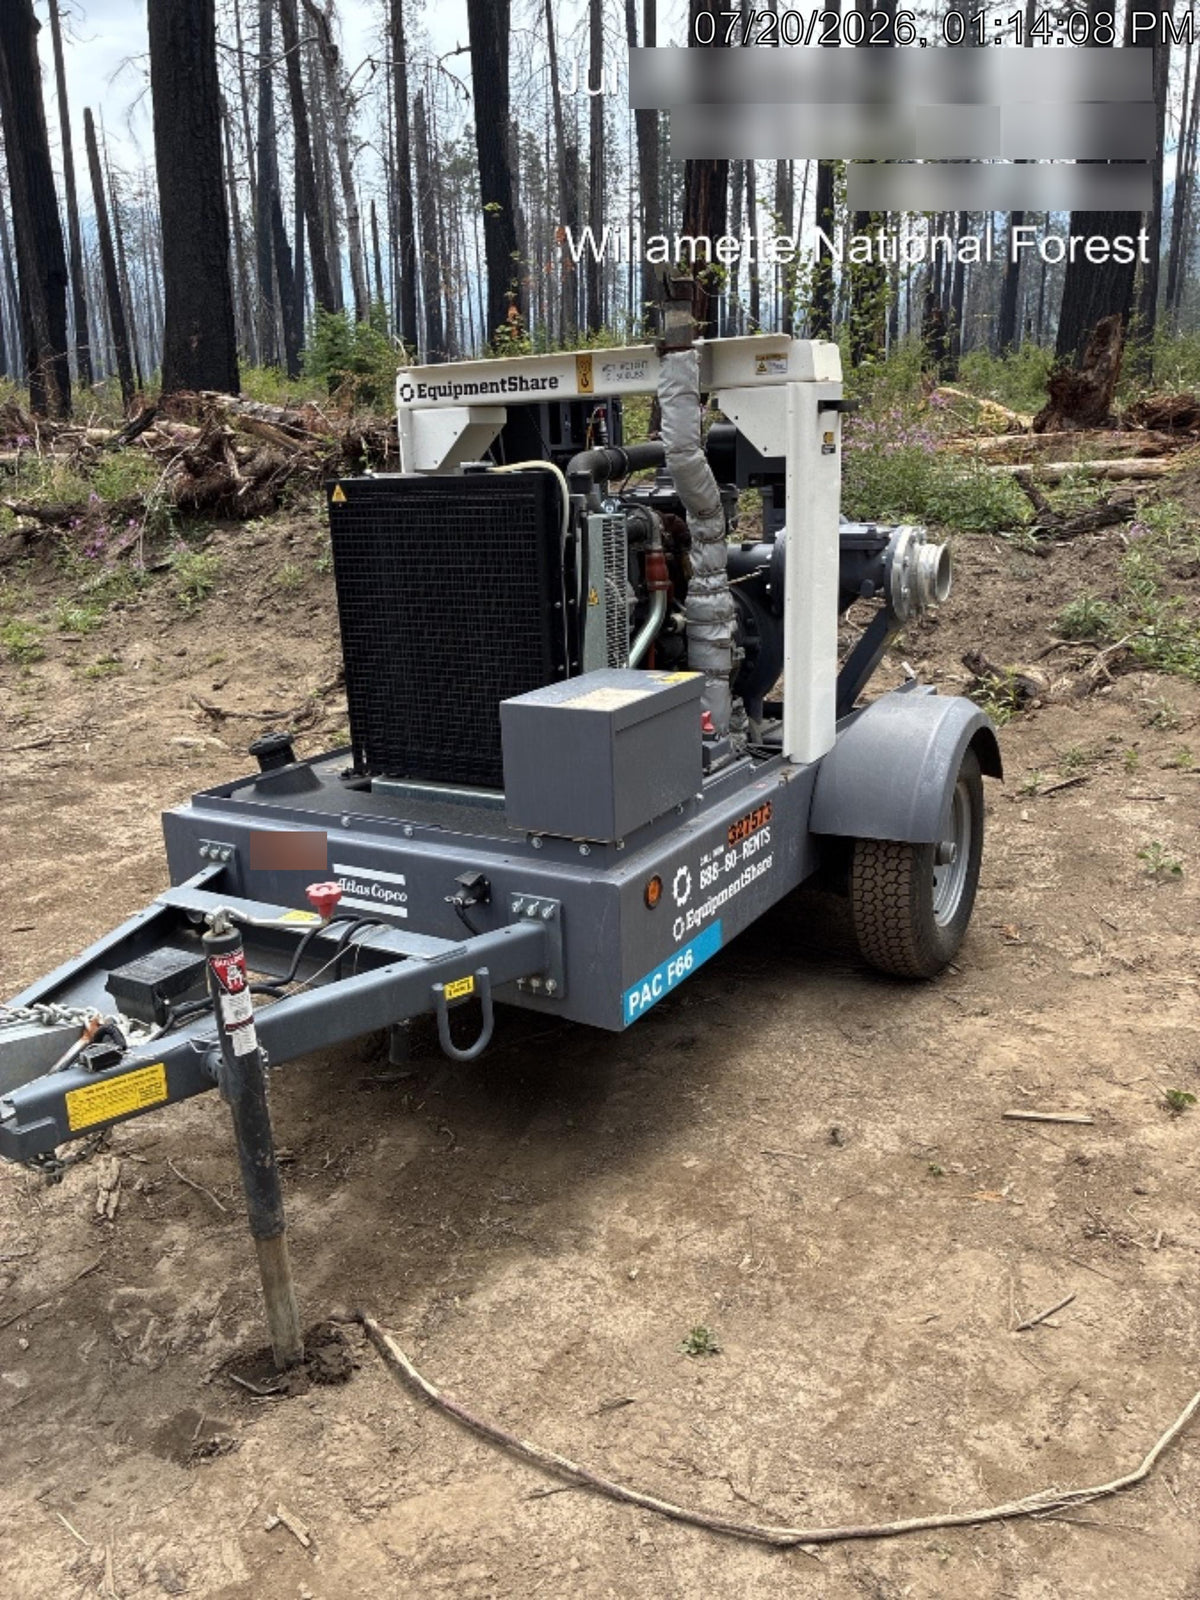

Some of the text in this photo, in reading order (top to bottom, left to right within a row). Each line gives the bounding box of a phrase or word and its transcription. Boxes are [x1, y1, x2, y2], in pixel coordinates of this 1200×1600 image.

[416, 375, 560, 401] EquipmentShare
[371, 884, 408, 903] Copco
[685, 853, 774, 931] EquipmentShare
[628, 949, 694, 1016] PAC F66
